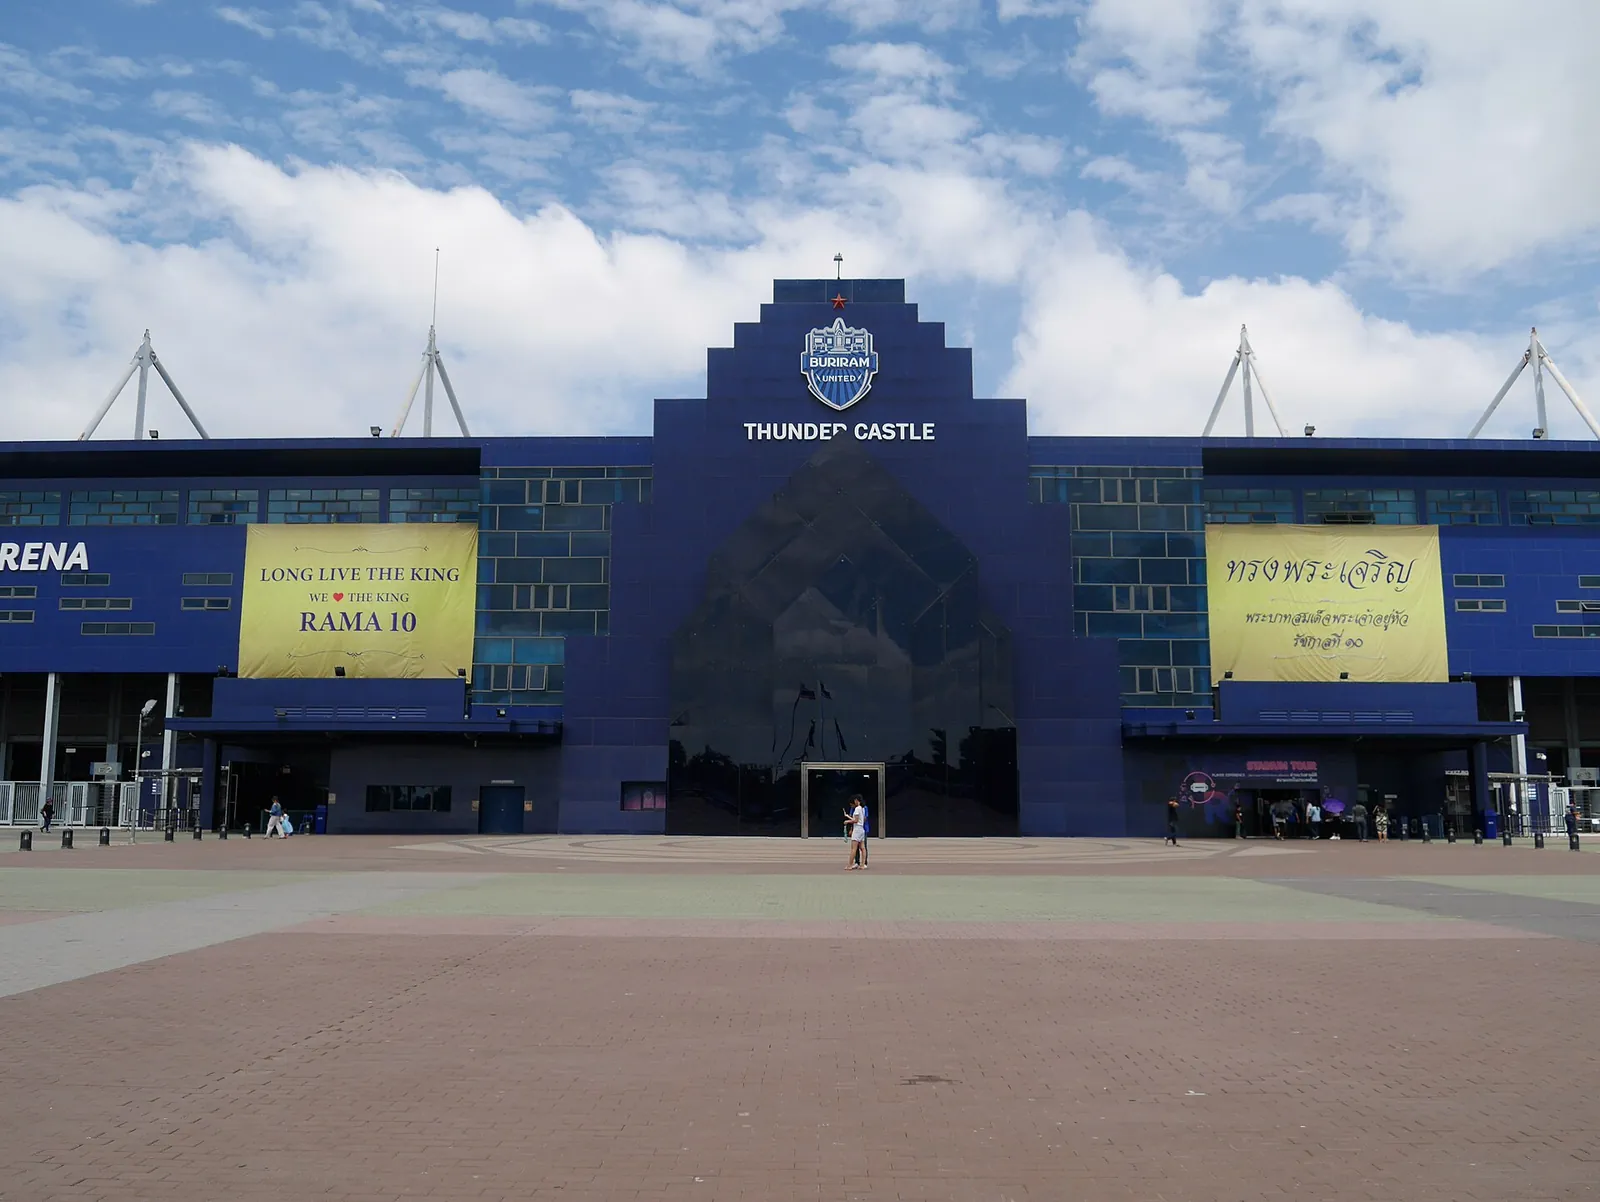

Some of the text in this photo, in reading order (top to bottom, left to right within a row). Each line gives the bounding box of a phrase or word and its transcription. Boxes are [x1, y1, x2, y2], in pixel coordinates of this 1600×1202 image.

[809, 357, 870, 368] BURIRAM
[822, 374, 857, 383] UNITED
[854, 422, 936, 441] CASTLE
[260, 567, 460, 582] LONG LIVE THE KING
[1225, 549, 1419, 592] ทรงพระเจริญ
[309, 592, 410, 603] WE THE KING
[299, 611, 417, 632] RAMA 10
[1245, 609, 1409, 631] พระบาทสมเด็จพระเจ้าอยู่หัว
